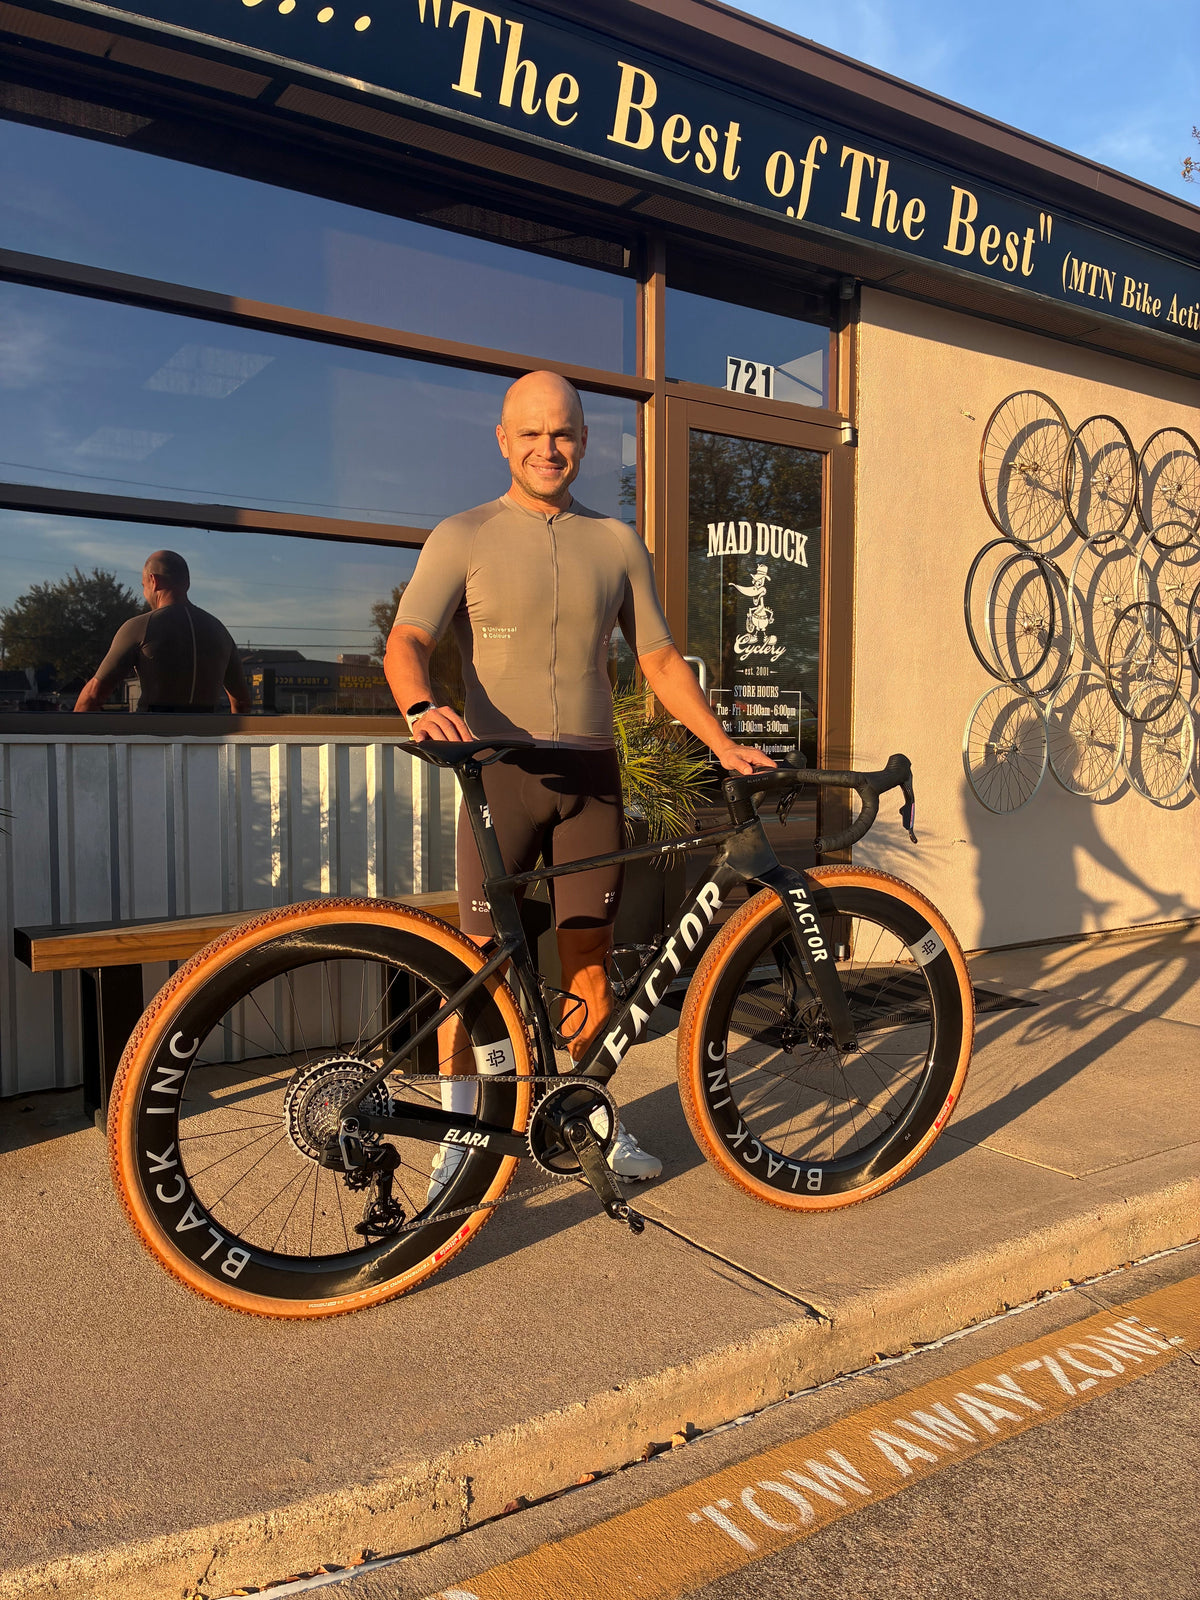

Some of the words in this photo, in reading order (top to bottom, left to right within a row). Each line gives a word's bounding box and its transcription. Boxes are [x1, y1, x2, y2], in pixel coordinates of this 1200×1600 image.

[607, 61, 742, 180] Best
[765, 136, 828, 220] of
[841, 146, 925, 240] The
[943, 186, 1053, 277] Best"
[1062, 250, 1117, 303] (MTN
[1121, 275, 1161, 318] Bike
[1166, 293, 1200, 331] Acti
[729, 358, 771, 397] 721
[707, 521, 752, 557] MAD
[755, 522, 809, 567] DUCK
[734, 634, 787, 662] Cyclery
[733, 685, 756, 698] STORE
[756, 685, 779, 698] HOURS
[755, 666, 769, 677] 2001
[716, 703, 729, 716] Tue
[732, 703, 741, 716] Fri
[746, 703, 771, 716] 11:00am
[773, 704, 796, 718] 6:00pm
[722, 720, 732, 733] Sat
[738, 720, 763, 733] 10:00am
[766, 720, 789, 734] 5:00pm
[762, 743, 796, 754] Appointment
[788, 888, 828, 963] FACTOR
[603, 881, 723, 1068] FACTOR
[146, 1030, 199, 1114] INC
[707, 1040, 731, 1110] INC
[443, 1128, 491, 1148] ELARA
[726, 1119, 823, 1191] BLACK
[146, 1141, 251, 1279] BLACK
[687, 1449, 873, 1551] TOW
[868, 1373, 1045, 1477] AWAY
[1019, 1315, 1185, 1396] ZONE
